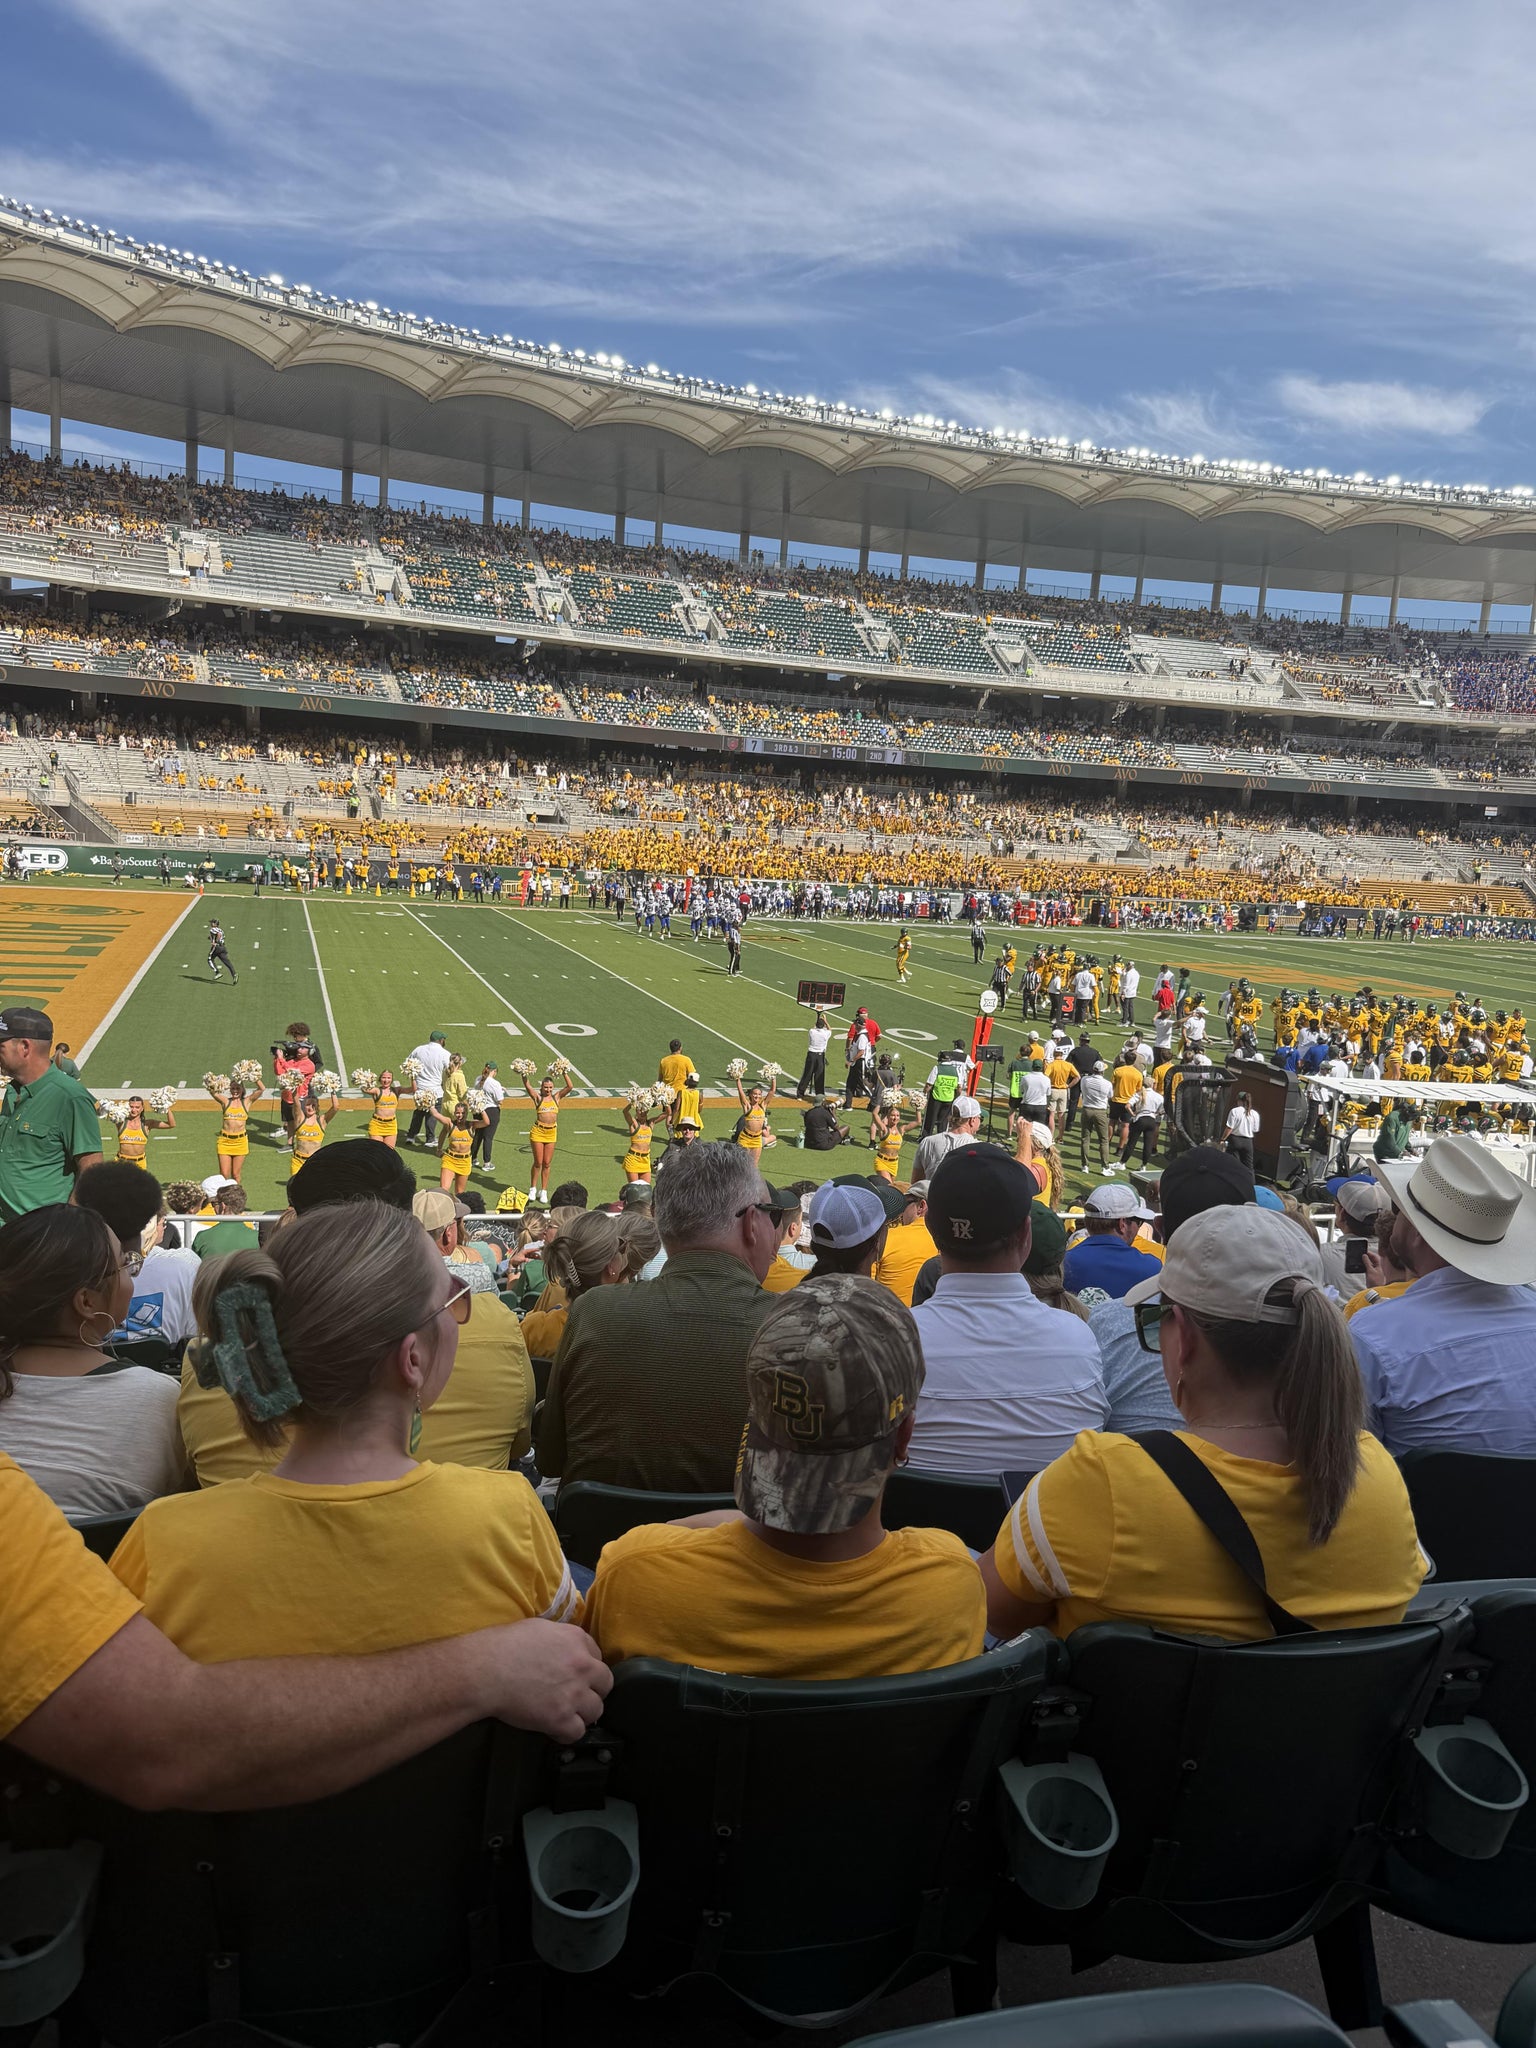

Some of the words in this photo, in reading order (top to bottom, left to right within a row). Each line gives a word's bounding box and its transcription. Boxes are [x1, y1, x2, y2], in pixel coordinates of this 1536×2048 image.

[141, 682, 175, 697] AVO
[301, 696, 332, 711] AVO
[751, 740, 758, 752] 7
[831, 746, 858, 760] 15:00
[869, 752, 882, 760] 2ND
[892, 752, 898, 763] 7
[980, 759, 1005, 771] AVO
[1048, 764, 1072, 776] AVO
[1113, 768, 1138, 780] AVO
[1179, 772, 1203, 785] AVO
[1243, 777, 1268, 789] AVO
[1307, 782, 1331, 793] AVO
[383, 871, 411, 880] AMO
[1062, 996, 1075, 1012] 3
[1242, 1005, 1253, 1014] 88
[487, 1022, 598, 1037] 10
[1510, 1060, 1523, 1072] 63
[773, 1369, 825, 1442] BU
